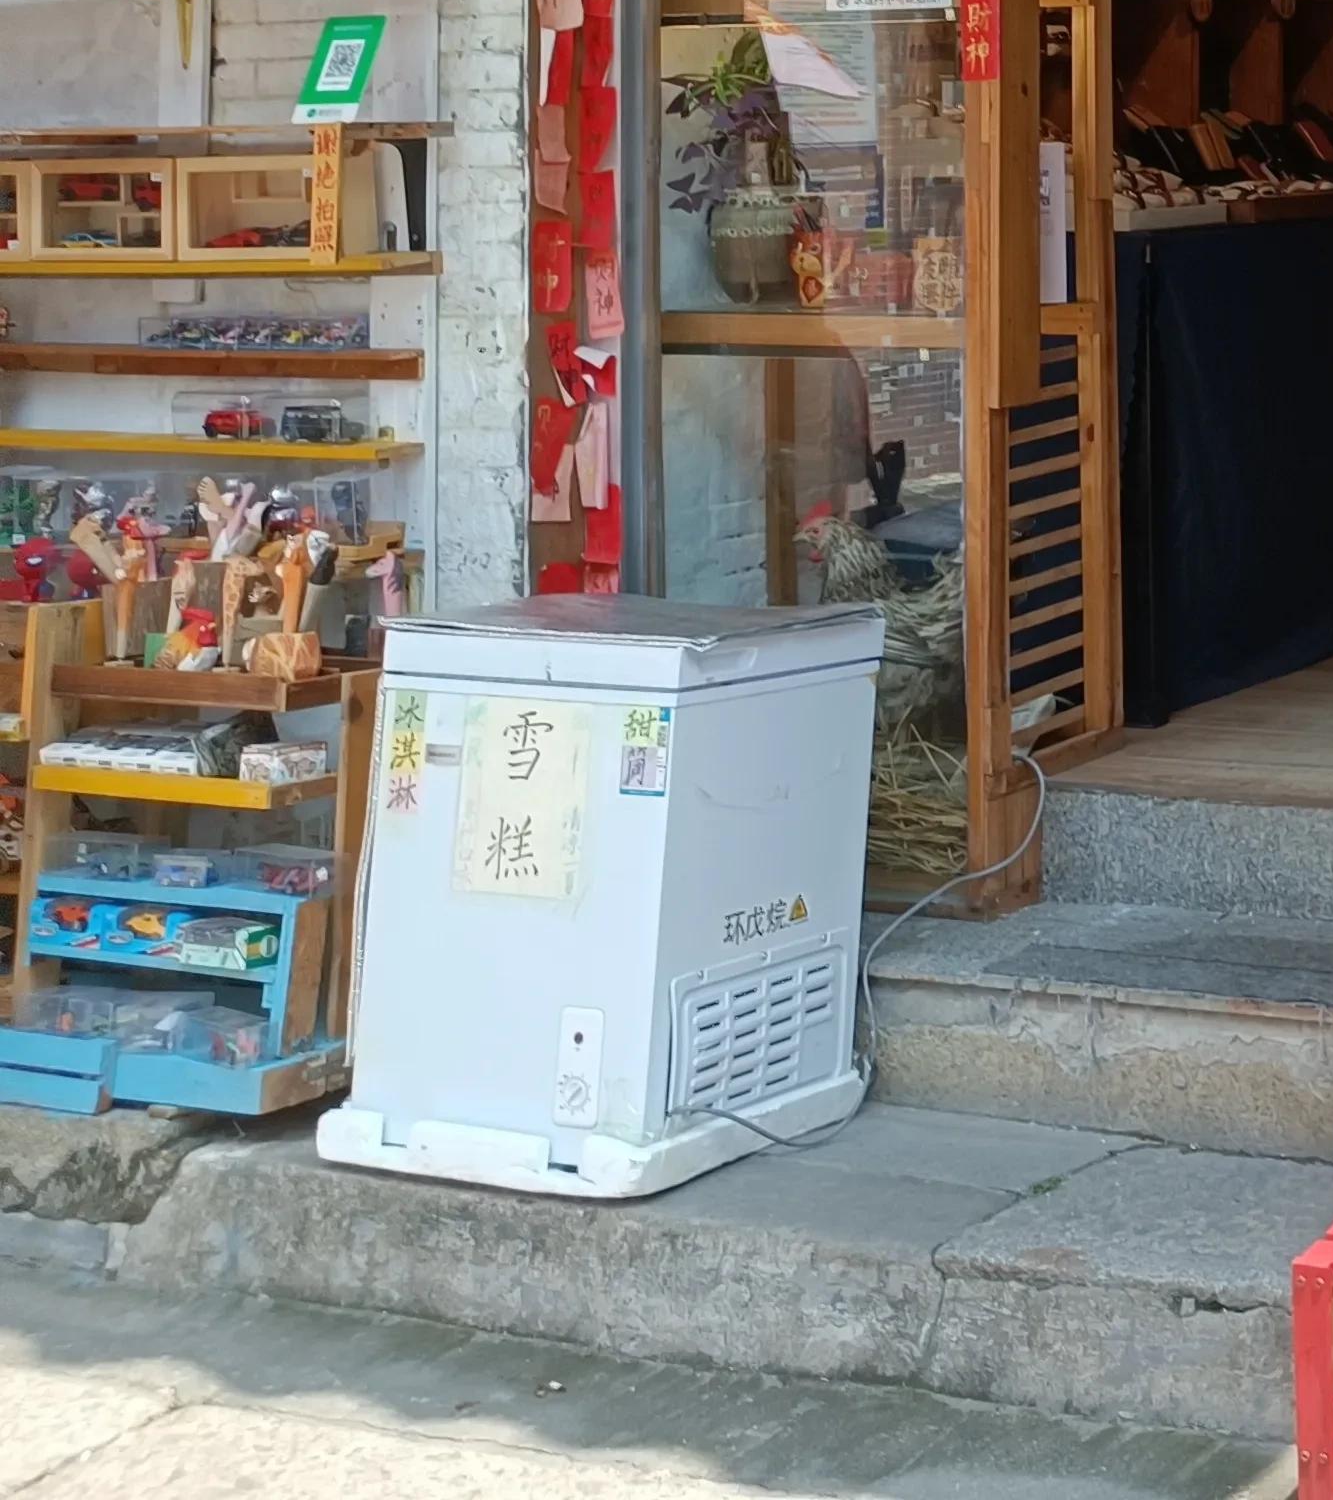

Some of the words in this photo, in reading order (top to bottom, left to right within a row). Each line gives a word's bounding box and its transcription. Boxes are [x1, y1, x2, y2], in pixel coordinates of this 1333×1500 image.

[387, 695, 424, 810] 冰淇淋
[484, 711, 553, 880] 雪糕
[622, 708, 656, 786] 甜筒
